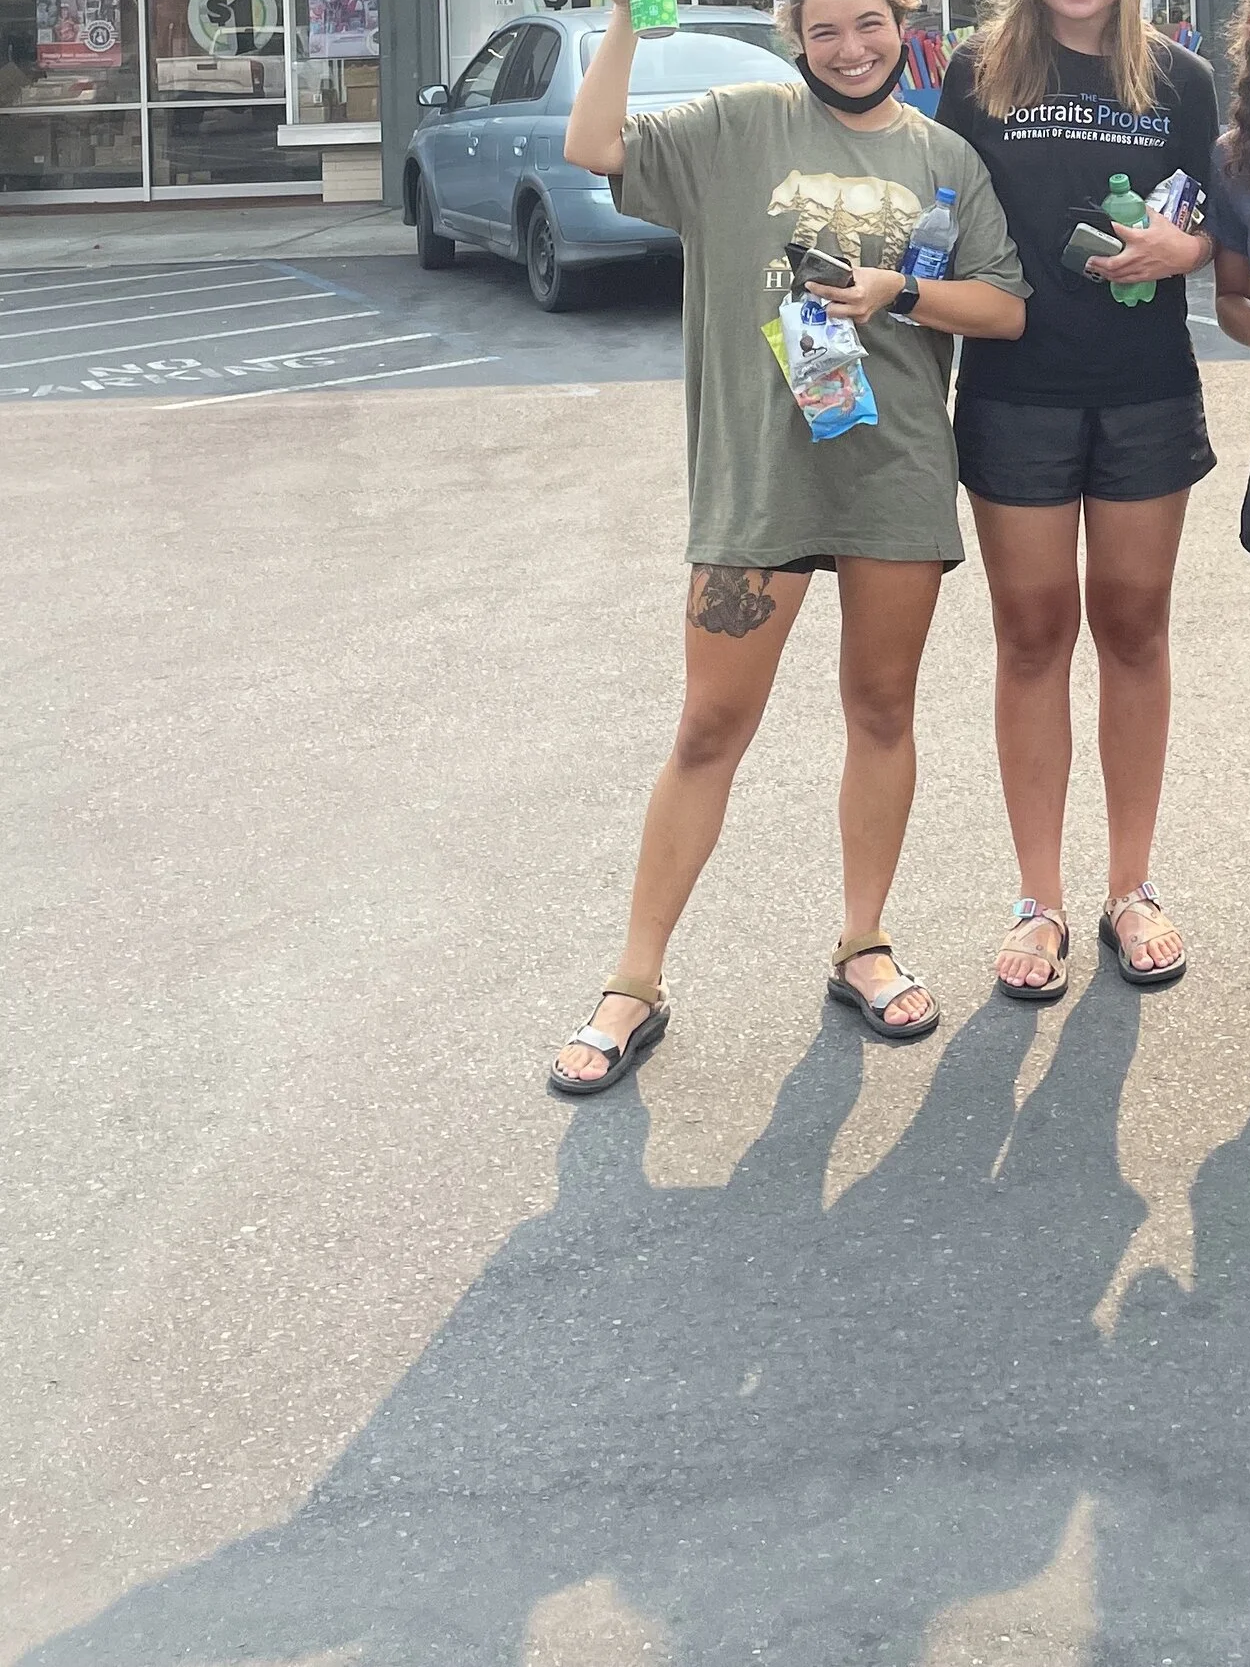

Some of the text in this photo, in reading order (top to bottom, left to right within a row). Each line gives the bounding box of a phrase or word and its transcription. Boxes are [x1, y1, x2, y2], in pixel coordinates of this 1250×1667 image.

[1080, 92, 1098, 102] THE
[1004, 101, 1171, 134] Portraits Project
[1003, 127, 1165, 147] A PORTRAIT OF CANCER ACROSS AMERICA
[87, 358, 202, 377] NO
